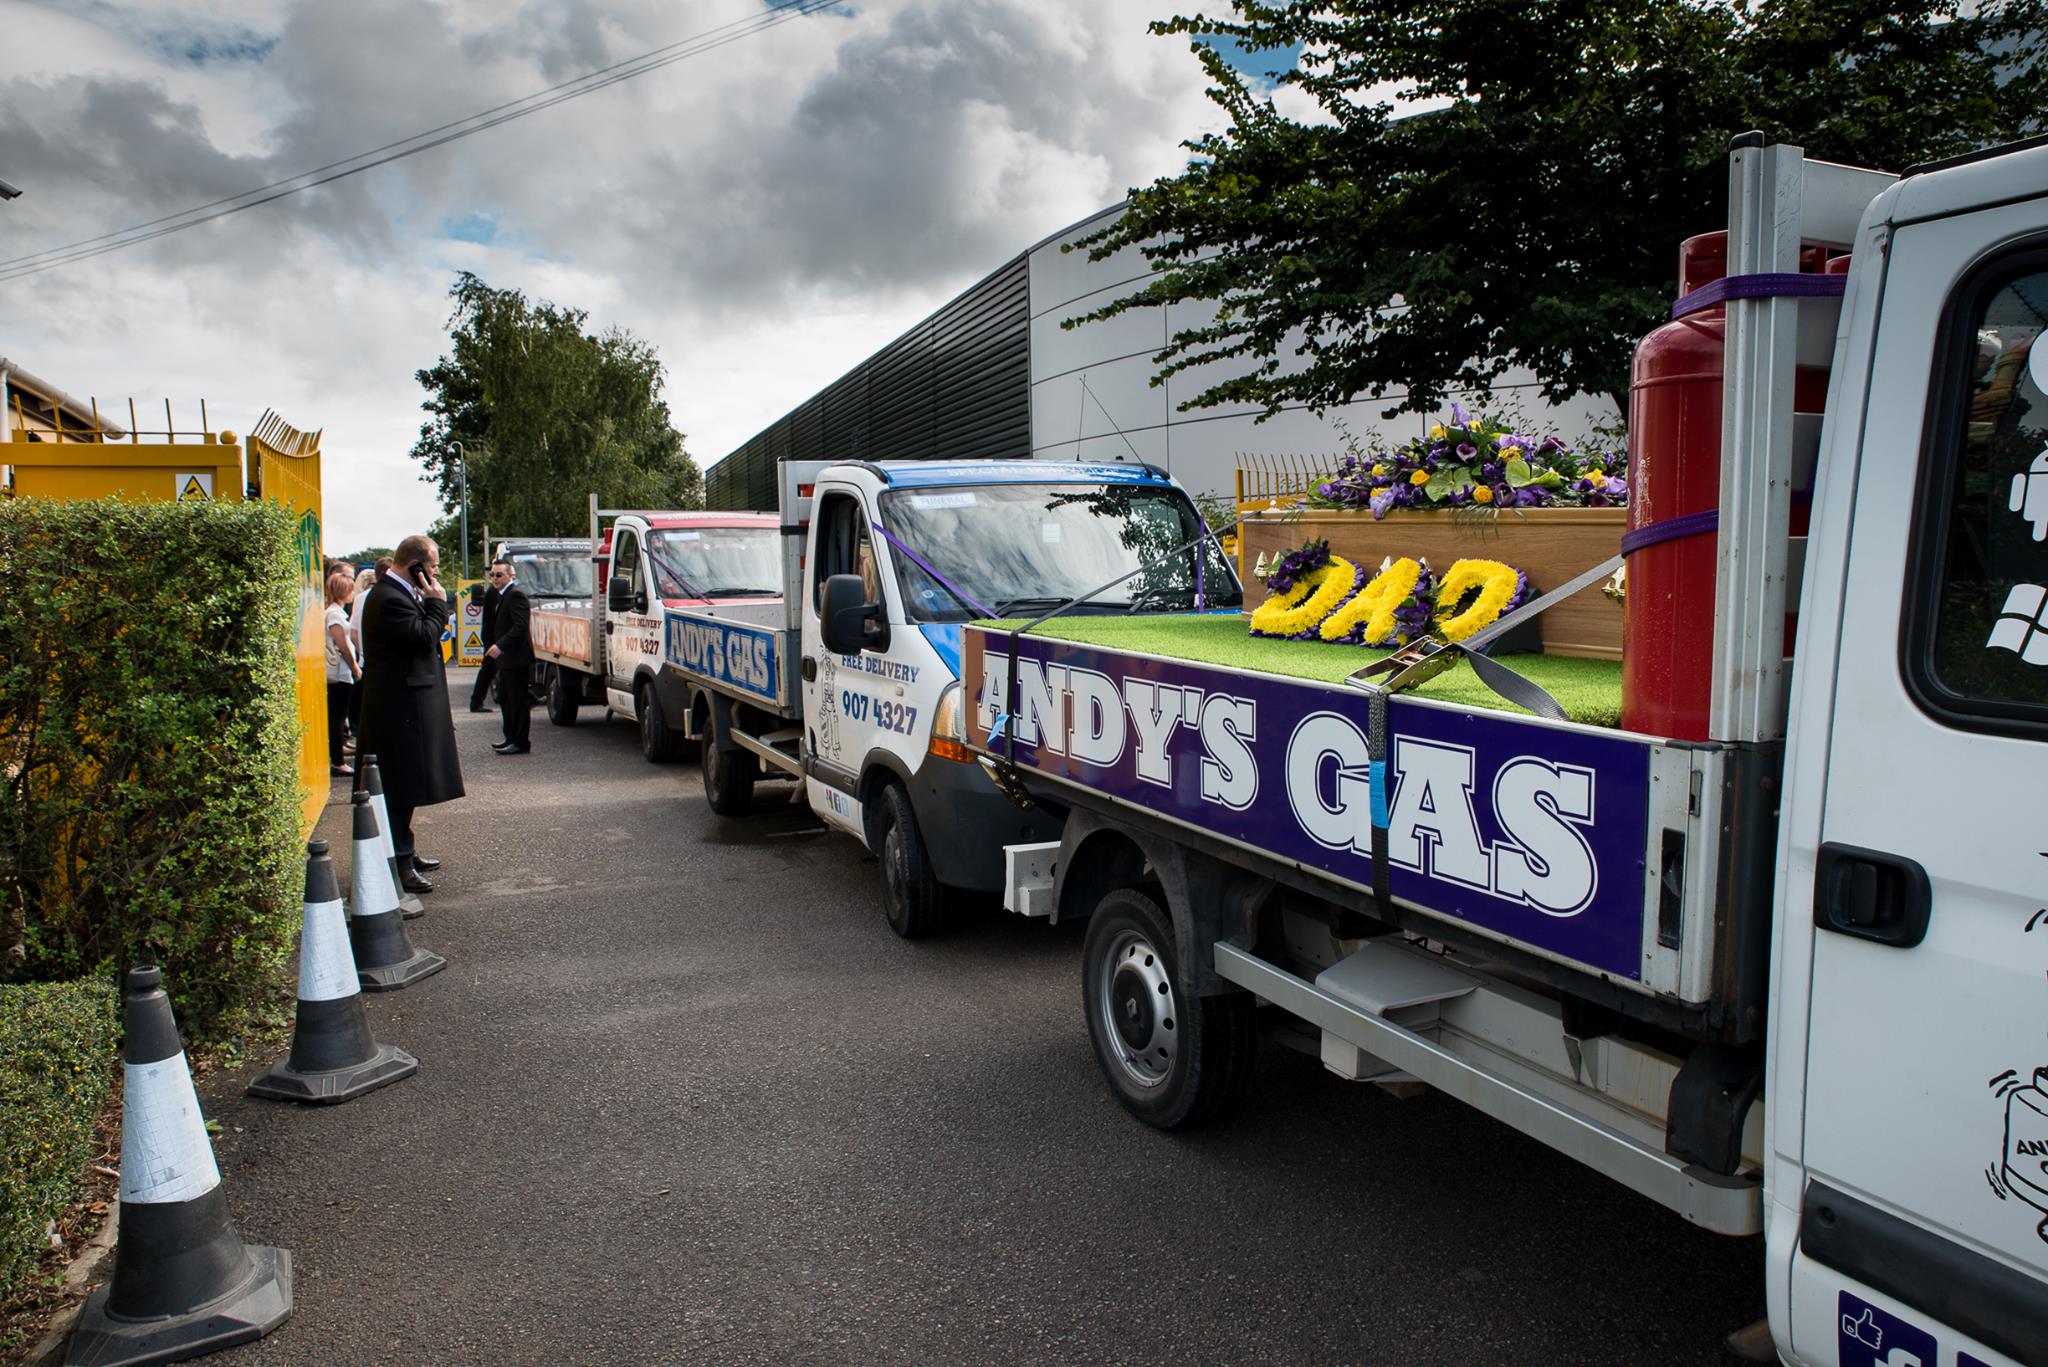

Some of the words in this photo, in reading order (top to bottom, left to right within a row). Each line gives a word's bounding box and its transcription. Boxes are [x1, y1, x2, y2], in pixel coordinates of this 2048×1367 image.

[562, 621, 586, 657] GAS
[637, 617, 663, 630] DELIVERY
[626, 636, 638, 652] 907
[640, 638, 660, 656] 4327
[669, 618, 725, 677] ANDY'S
[727, 631, 769, 691] GAS
[842, 654, 863, 671] FREE
[865, 656, 920, 683] DELIVERY
[842, 690, 868, 722] 907
[873, 698, 918, 736] 4327
[976, 650, 1259, 811] ANDY'S
[1285, 710, 1598, 918] GAS
